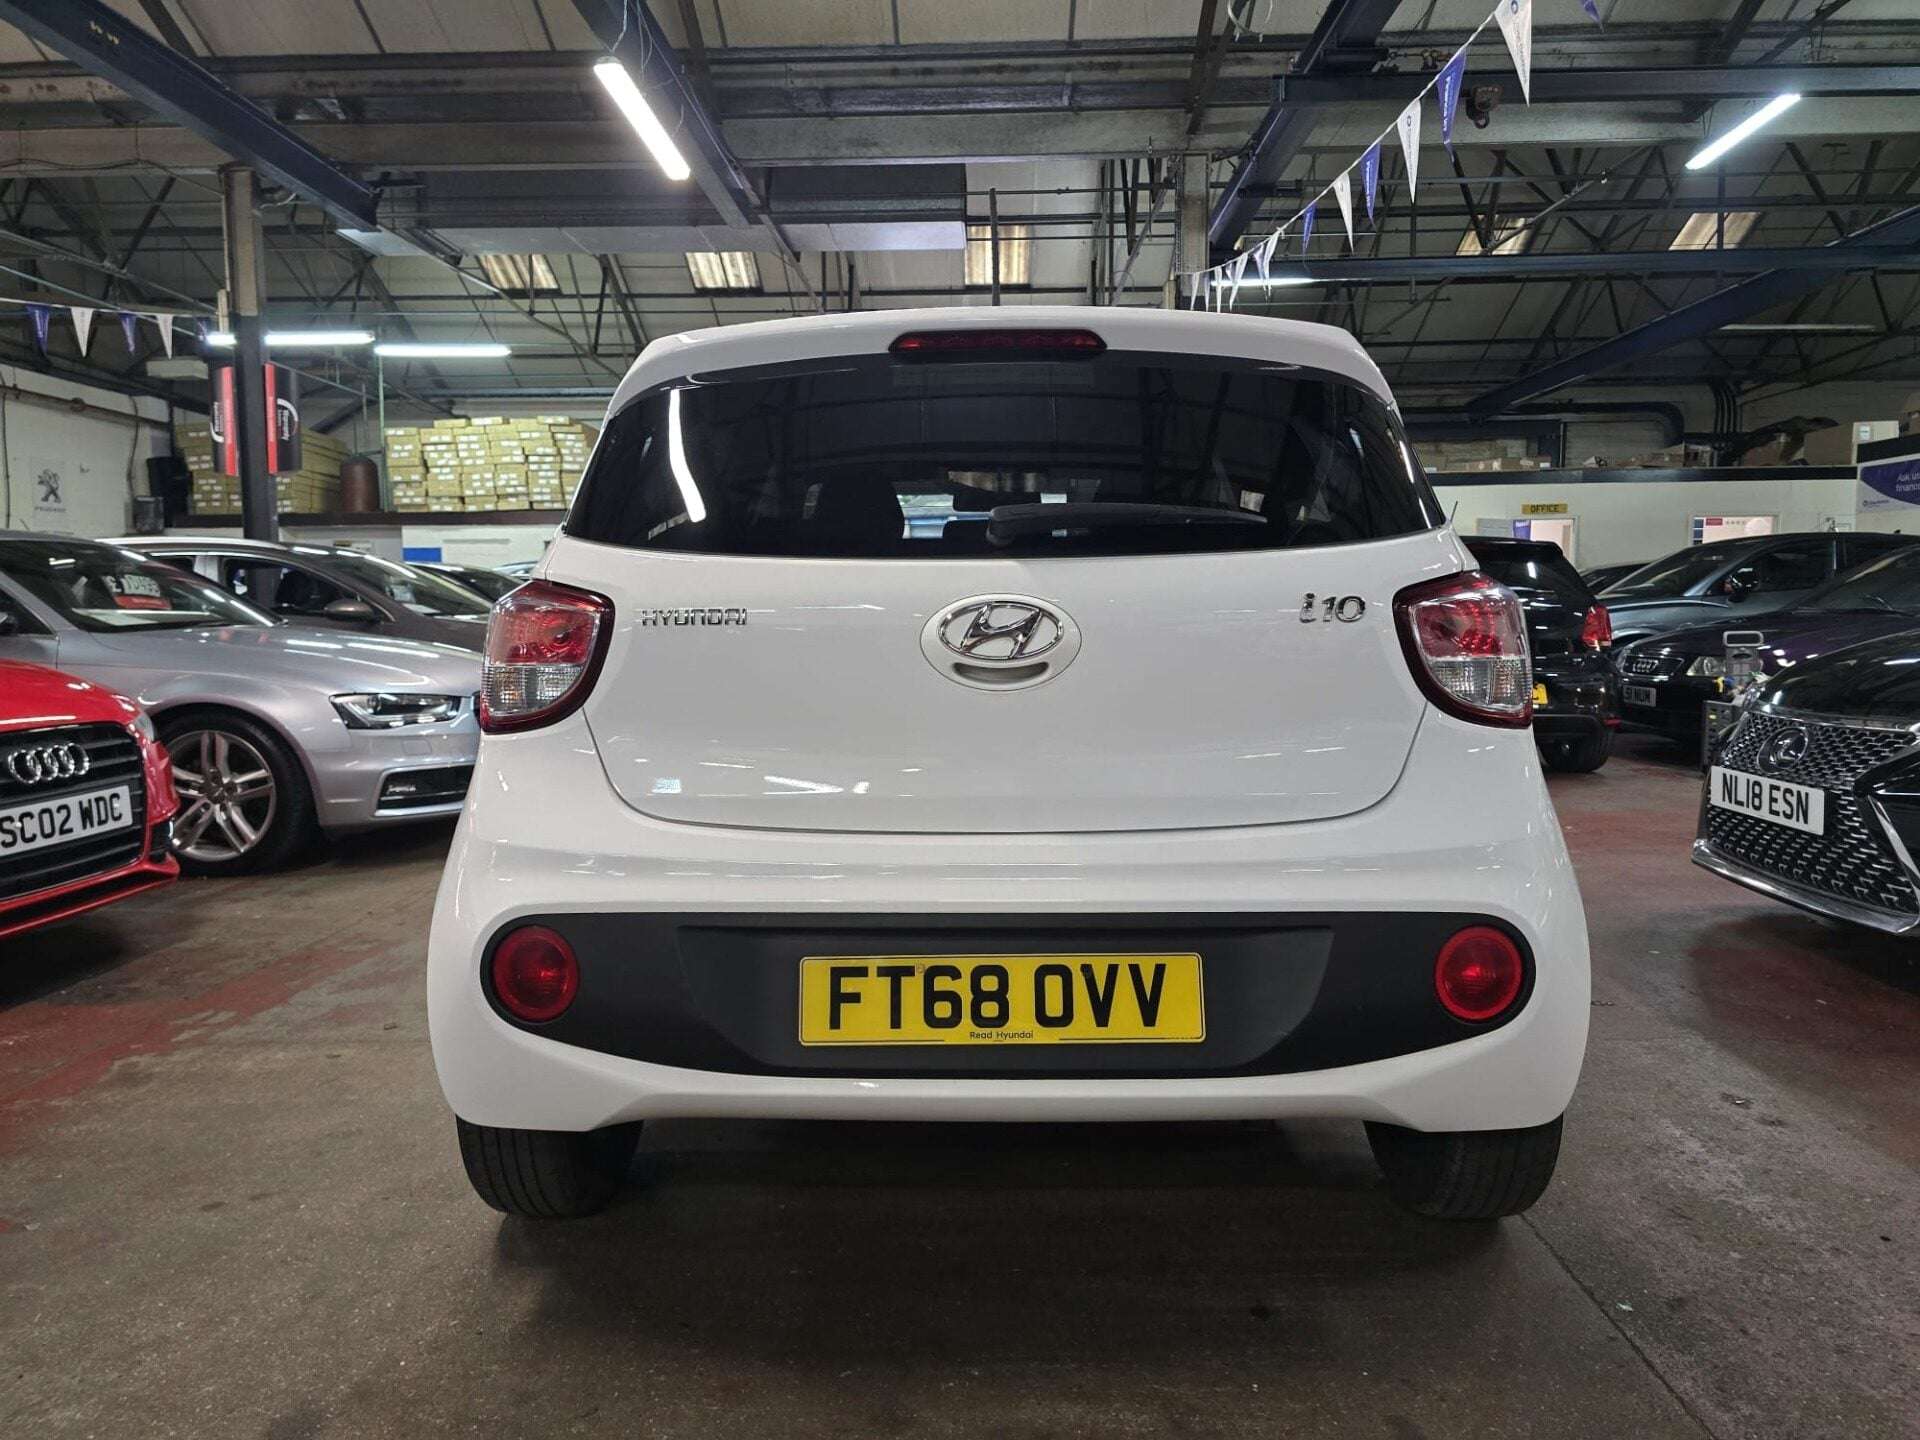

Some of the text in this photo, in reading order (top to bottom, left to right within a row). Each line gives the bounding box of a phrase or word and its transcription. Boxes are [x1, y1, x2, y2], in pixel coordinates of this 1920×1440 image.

[1530, 503, 1560, 513] OFFICE
[641, 607, 747, 626] HYUNDAI
[1299, 592, 1366, 624] i10
[1722, 772, 1810, 826] NL18 ESN
[0, 792, 123, 849] SC02 WDC
[828, 962, 1167, 1030] FT68 OVV
[969, 1030, 1034, 1041] Read Hyundai
